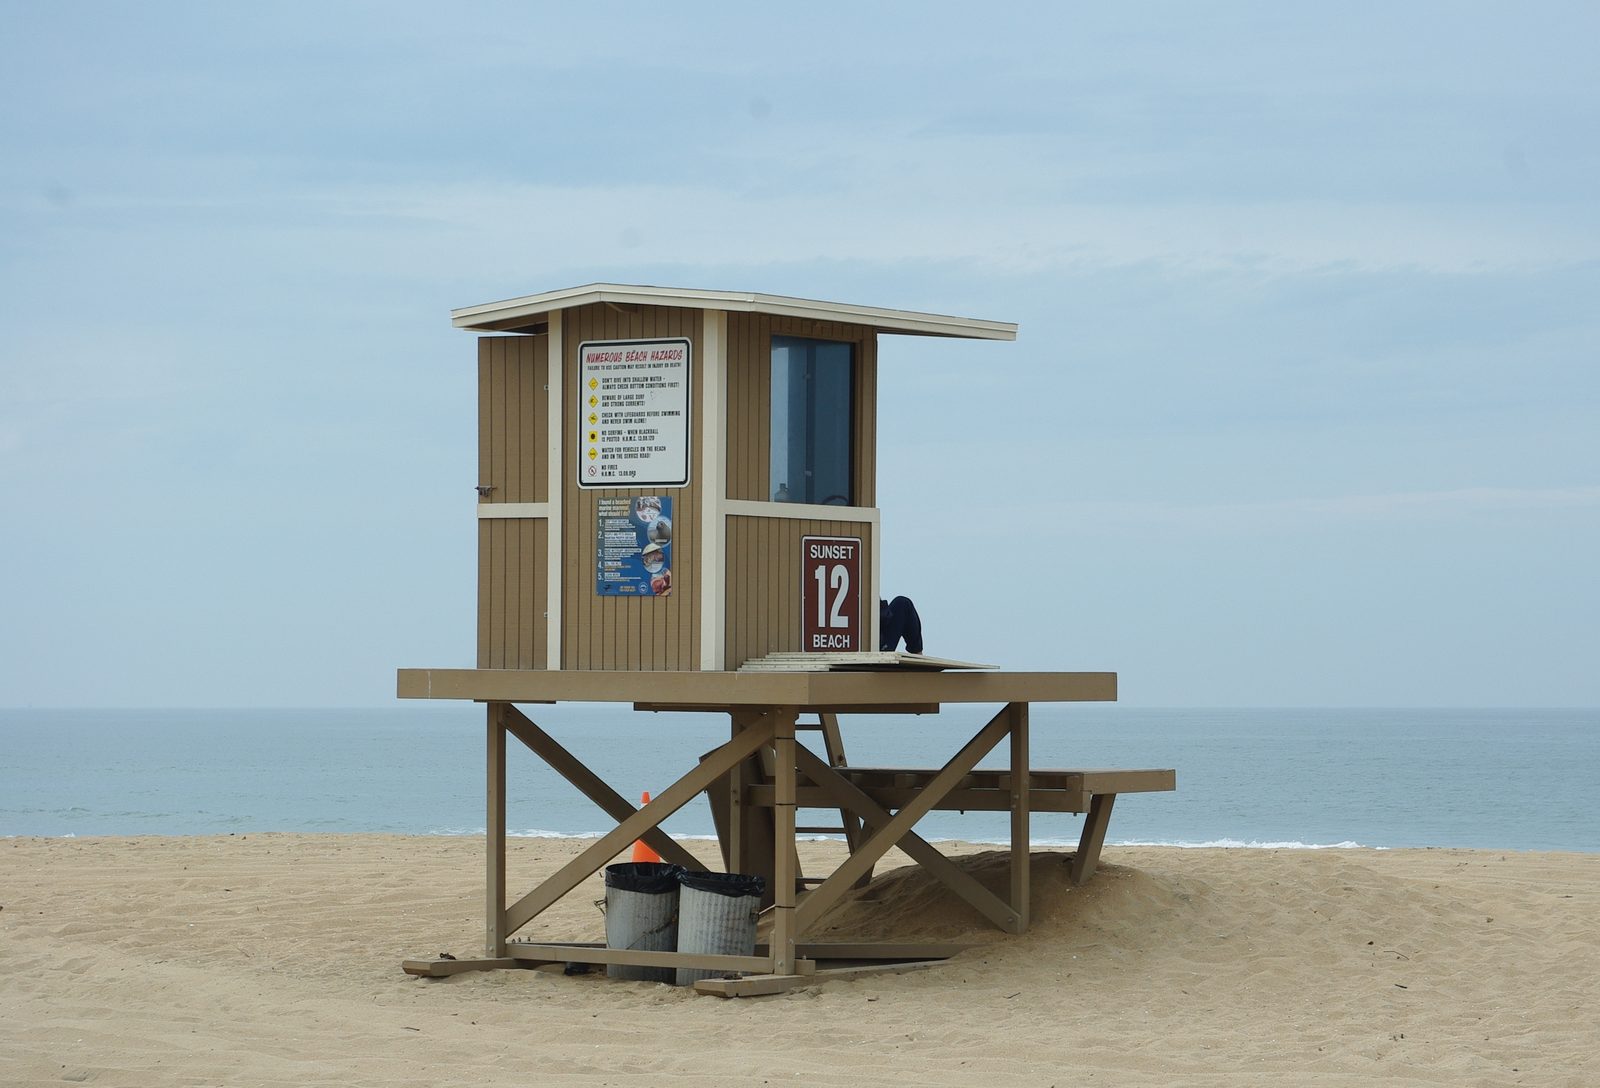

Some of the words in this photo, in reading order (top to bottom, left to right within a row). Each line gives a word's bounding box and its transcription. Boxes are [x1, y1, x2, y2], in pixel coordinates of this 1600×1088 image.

[586, 352, 623, 363] NUMEROUS
[626, 351, 648, 362] BEACH
[651, 350, 682, 360] HAZARDS
[810, 545, 853, 559] SUNSET
[815, 564, 849, 628] 12
[813, 634, 850, 648] BEACH
